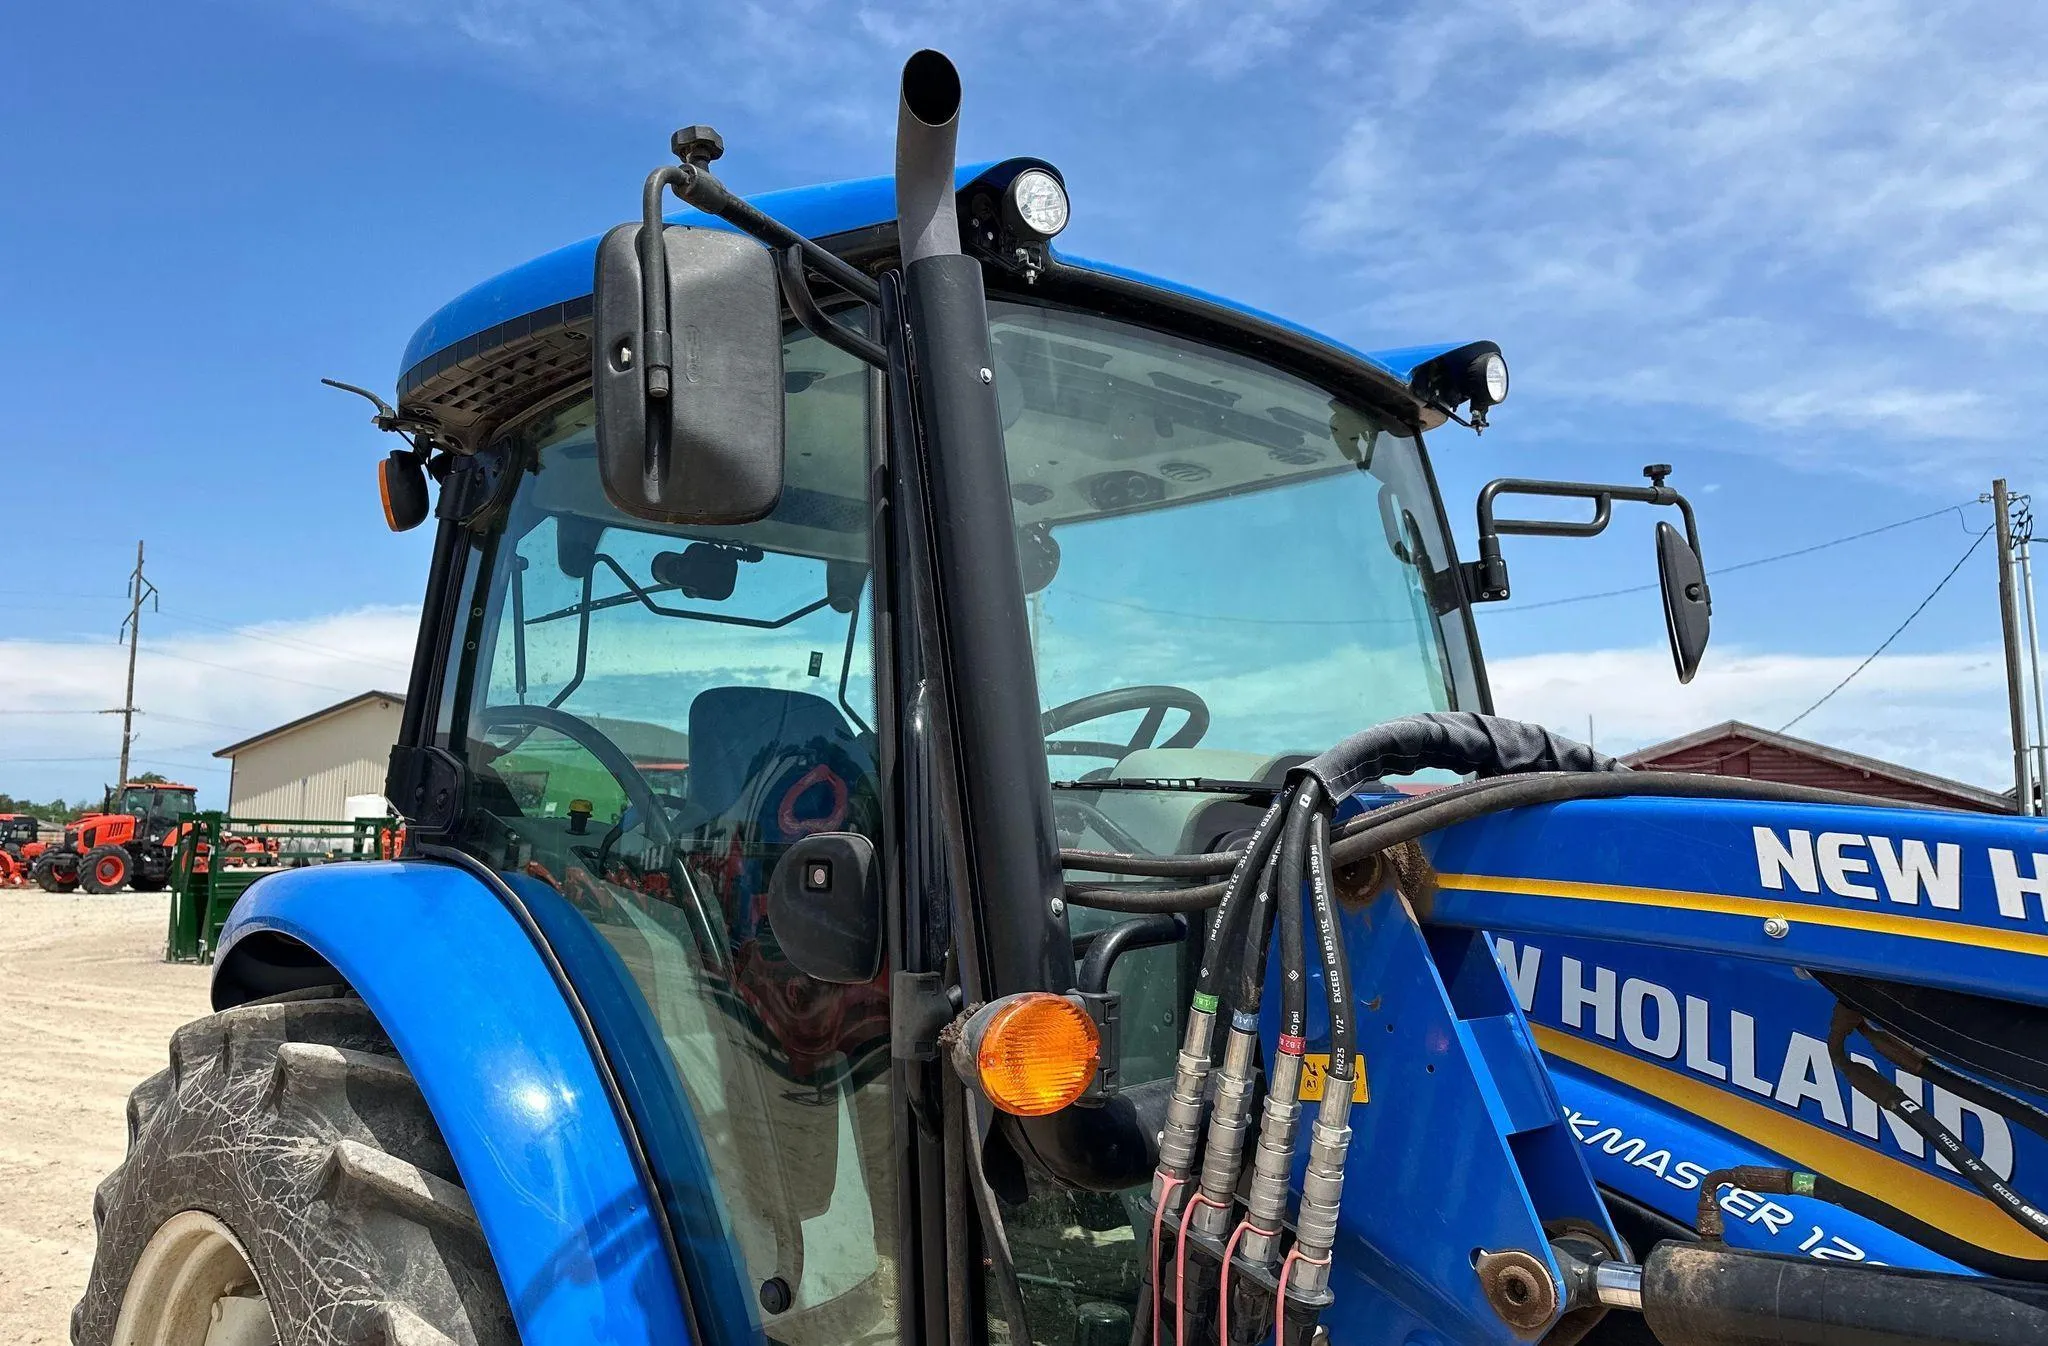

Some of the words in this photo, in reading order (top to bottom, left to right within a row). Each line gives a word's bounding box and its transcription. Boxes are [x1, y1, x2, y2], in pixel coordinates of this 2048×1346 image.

[1260, 803, 1280, 827] EXCEED
[1252, 830, 1262, 840] EN
[1245, 840, 1256, 854] 857
[1310, 844, 1320, 855] psi
[1237, 855, 1248, 869] 1SC
[1270, 854, 1279, 866] psi
[1310, 855, 1320, 875] 3260
[1752, 825, 1961, 911] NEW
[1228, 873, 1240, 891] 22.5
[1316, 894, 1326, 912] 22.5
[1214, 909, 1225, 929] 3260
[1320, 918, 1330, 934] 1SC
[1323, 935, 1334, 951] 857
[1326, 952, 1337, 965] EN
[1329, 970, 1342, 1003] EXCEED
[1291, 1010, 1301, 1024] psi
[1335, 1014, 1345, 1035] 1/2"
[1290, 1024, 1299, 1038] 60
[1335, 1047, 1345, 1076] TH225
[1561, 955, 2013, 1182] HOLLAND
[1306, 1080, 1317, 1088] A1
[1562, 1106, 1794, 1235] KMASER
[1939, 1133, 1960, 1152] TH225
[1992, 1183, 2020, 1206] EXCEED
